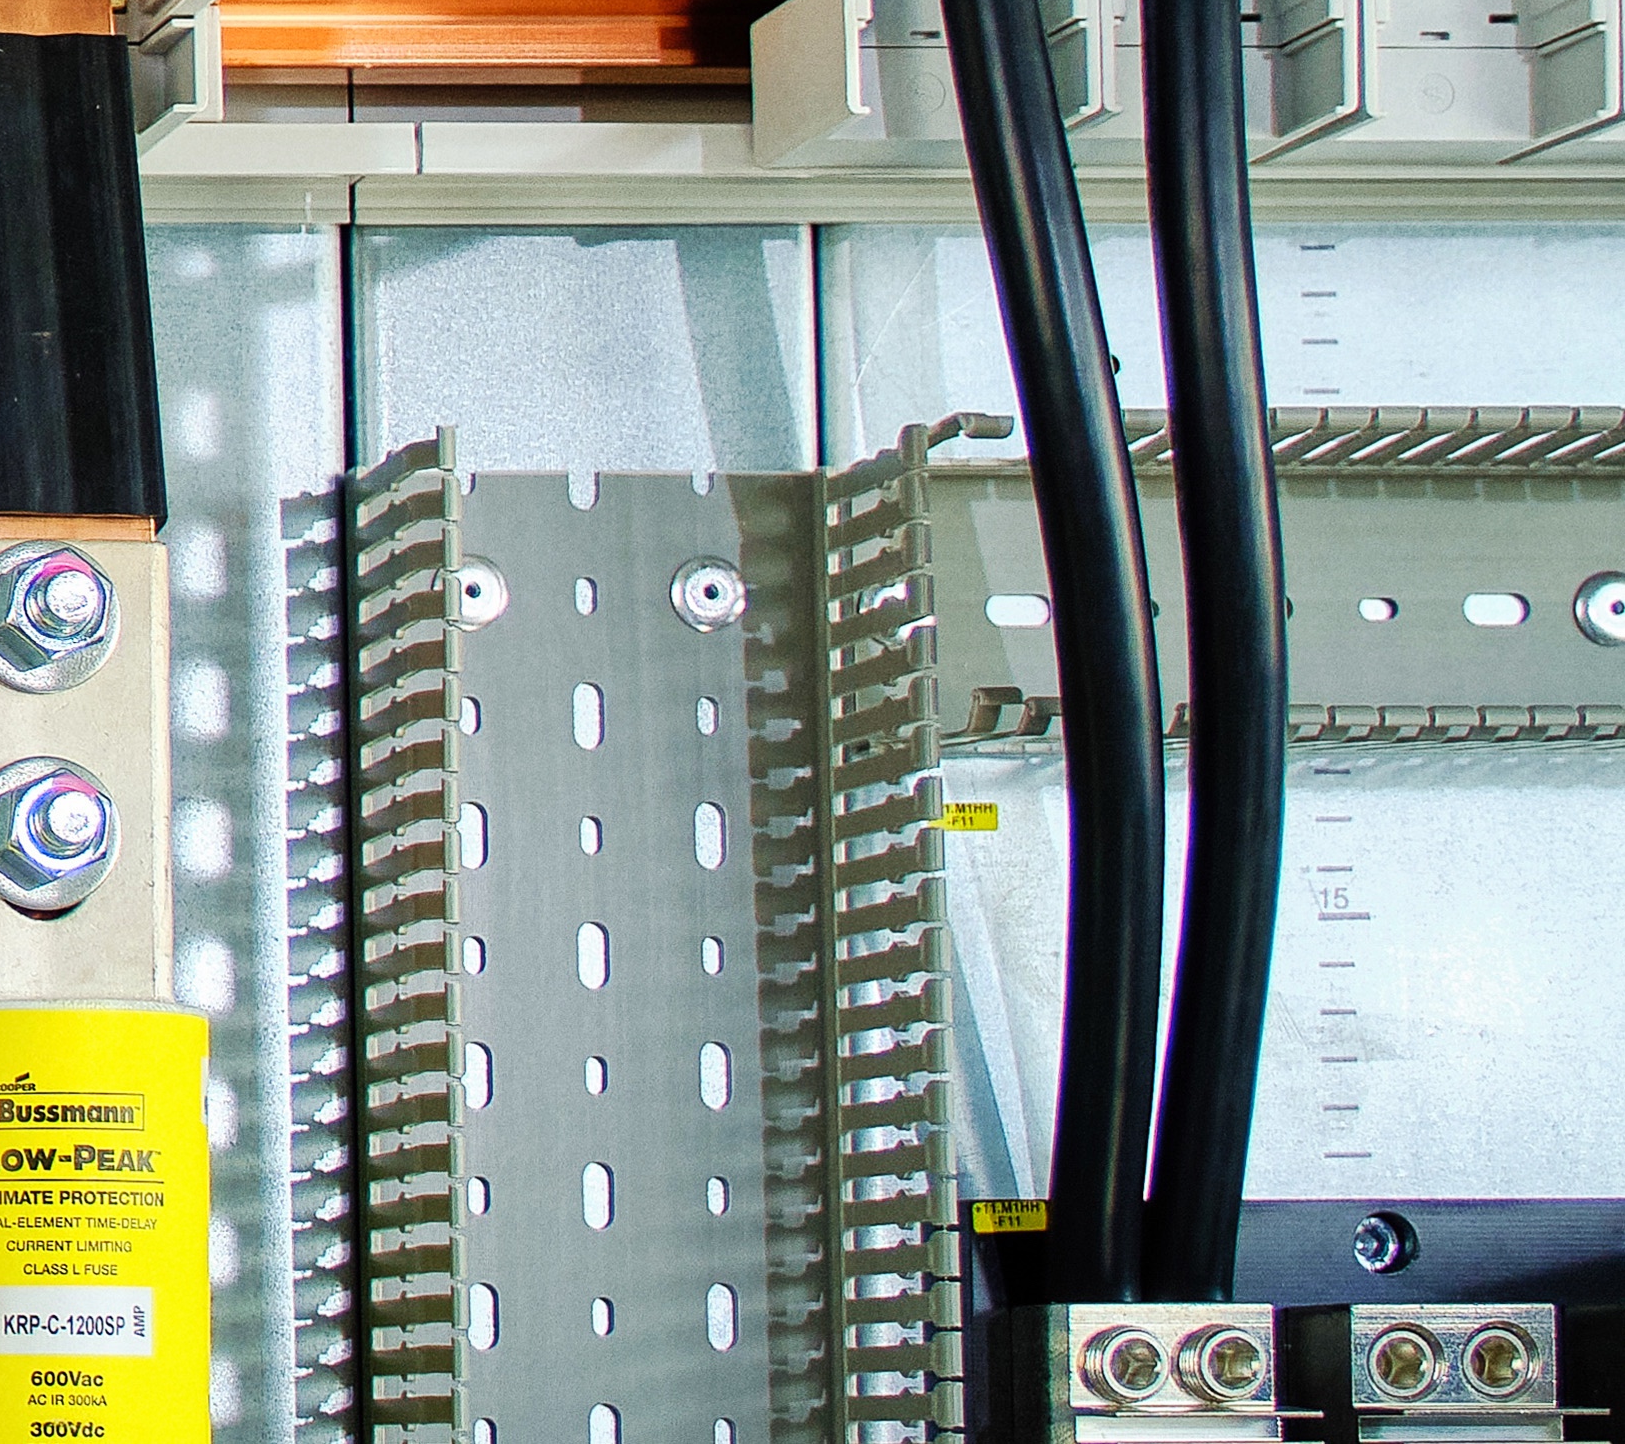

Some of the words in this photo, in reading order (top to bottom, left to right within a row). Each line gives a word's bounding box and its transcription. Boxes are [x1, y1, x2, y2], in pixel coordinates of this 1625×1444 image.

[1318, 888, 1349, 910] 15
[59, 1190, 164, 1207] PROTECTION
[84, 1216, 158, 1230] TIME-DELAY
[6, 1240, 72, 1253] CURRENT
[76, 1240, 132, 1253] LIMITING
[23, 1263, 69, 1276] CLASS
[73, 1263, 80, 1276] L
[83, 1263, 118, 1276] FUSE
[3, 1314, 126, 1336] KRP-C-1200SP
[133, 1305, 145, 1338] AMP
[30, 1371, 104, 1387] 600Vac
[28, 1394, 47, 1406] AC
[50, 1394, 64, 1406] IR
[67, 1394, 108, 1406] 300kA
[30, 1422, 105, 1439] 300Vdc
